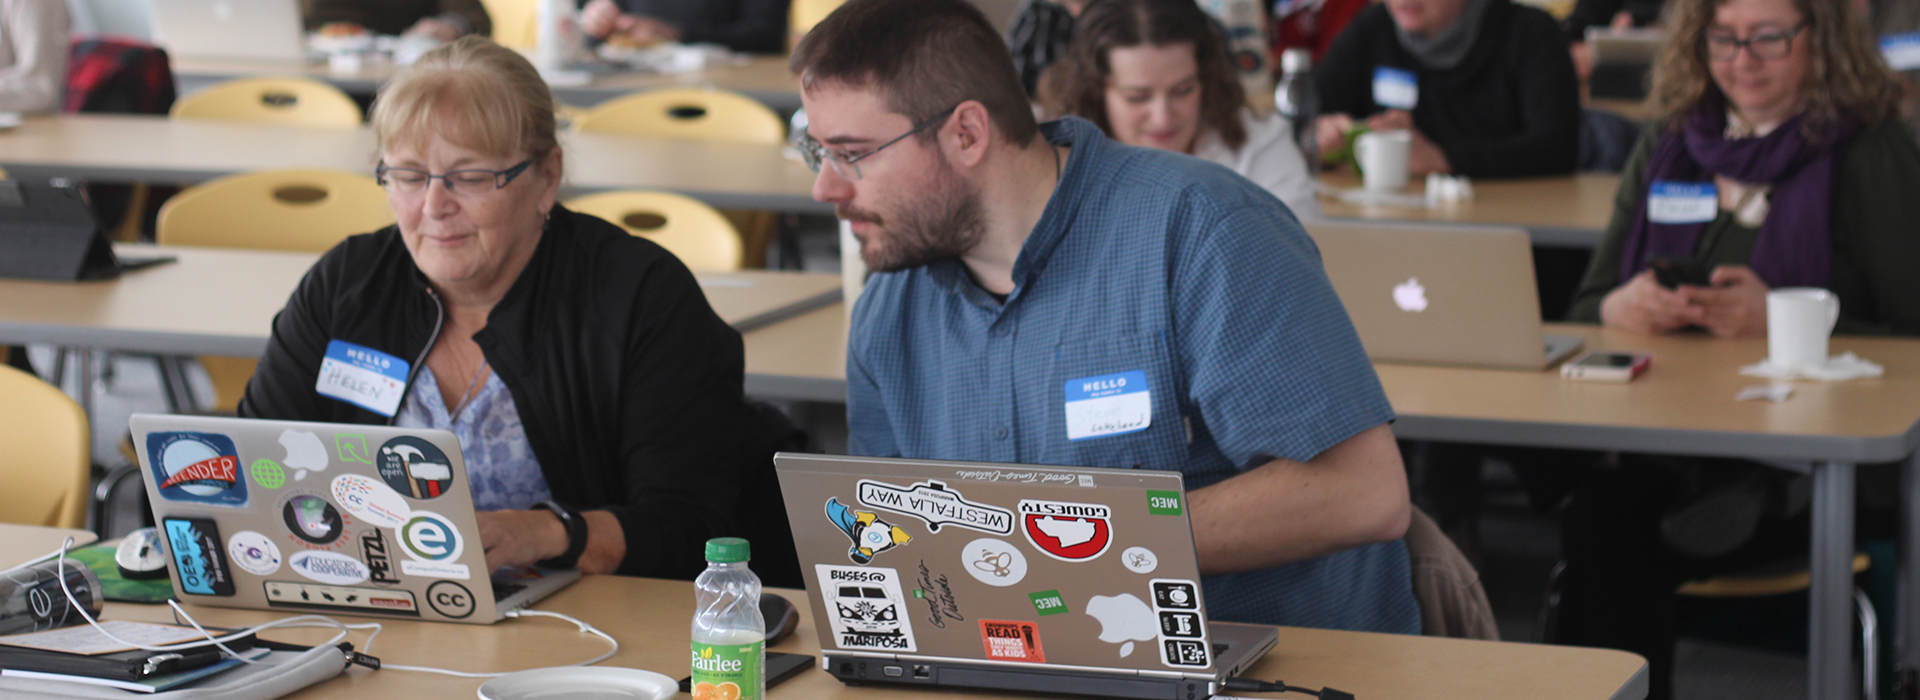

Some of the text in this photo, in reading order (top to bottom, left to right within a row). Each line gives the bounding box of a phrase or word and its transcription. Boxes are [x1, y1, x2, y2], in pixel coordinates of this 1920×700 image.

[347, 348, 391, 370] HELLO
[327, 367, 384, 400] HELEN
[1083, 377, 1127, 393] HELLO
[381, 468, 404, 480] open
[1041, 473, 1076, 485] Good
[930, 493, 954, 501] MARIPOSA
[1151, 496, 1178, 509] MEC
[867, 488, 1004, 529] WESTFALIA WAY
[1022, 503, 1107, 517] GOWESTY
[362, 527, 401, 584] PETZL
[311, 564, 364, 579] COOPERATIVE
[1157, 590, 1165, 600] EAT
[1035, 596, 1063, 610] MEC
[1163, 616, 1171, 632] SLEEP
[987, 628, 1021, 639] READ
[843, 635, 908, 649] MARIPOSA
[988, 637, 1024, 647] THINGS
[992, 648, 1027, 659] AS KIDS
[1168, 643, 1177, 660] CREATE
[692, 650, 742, 672] Fairlee
